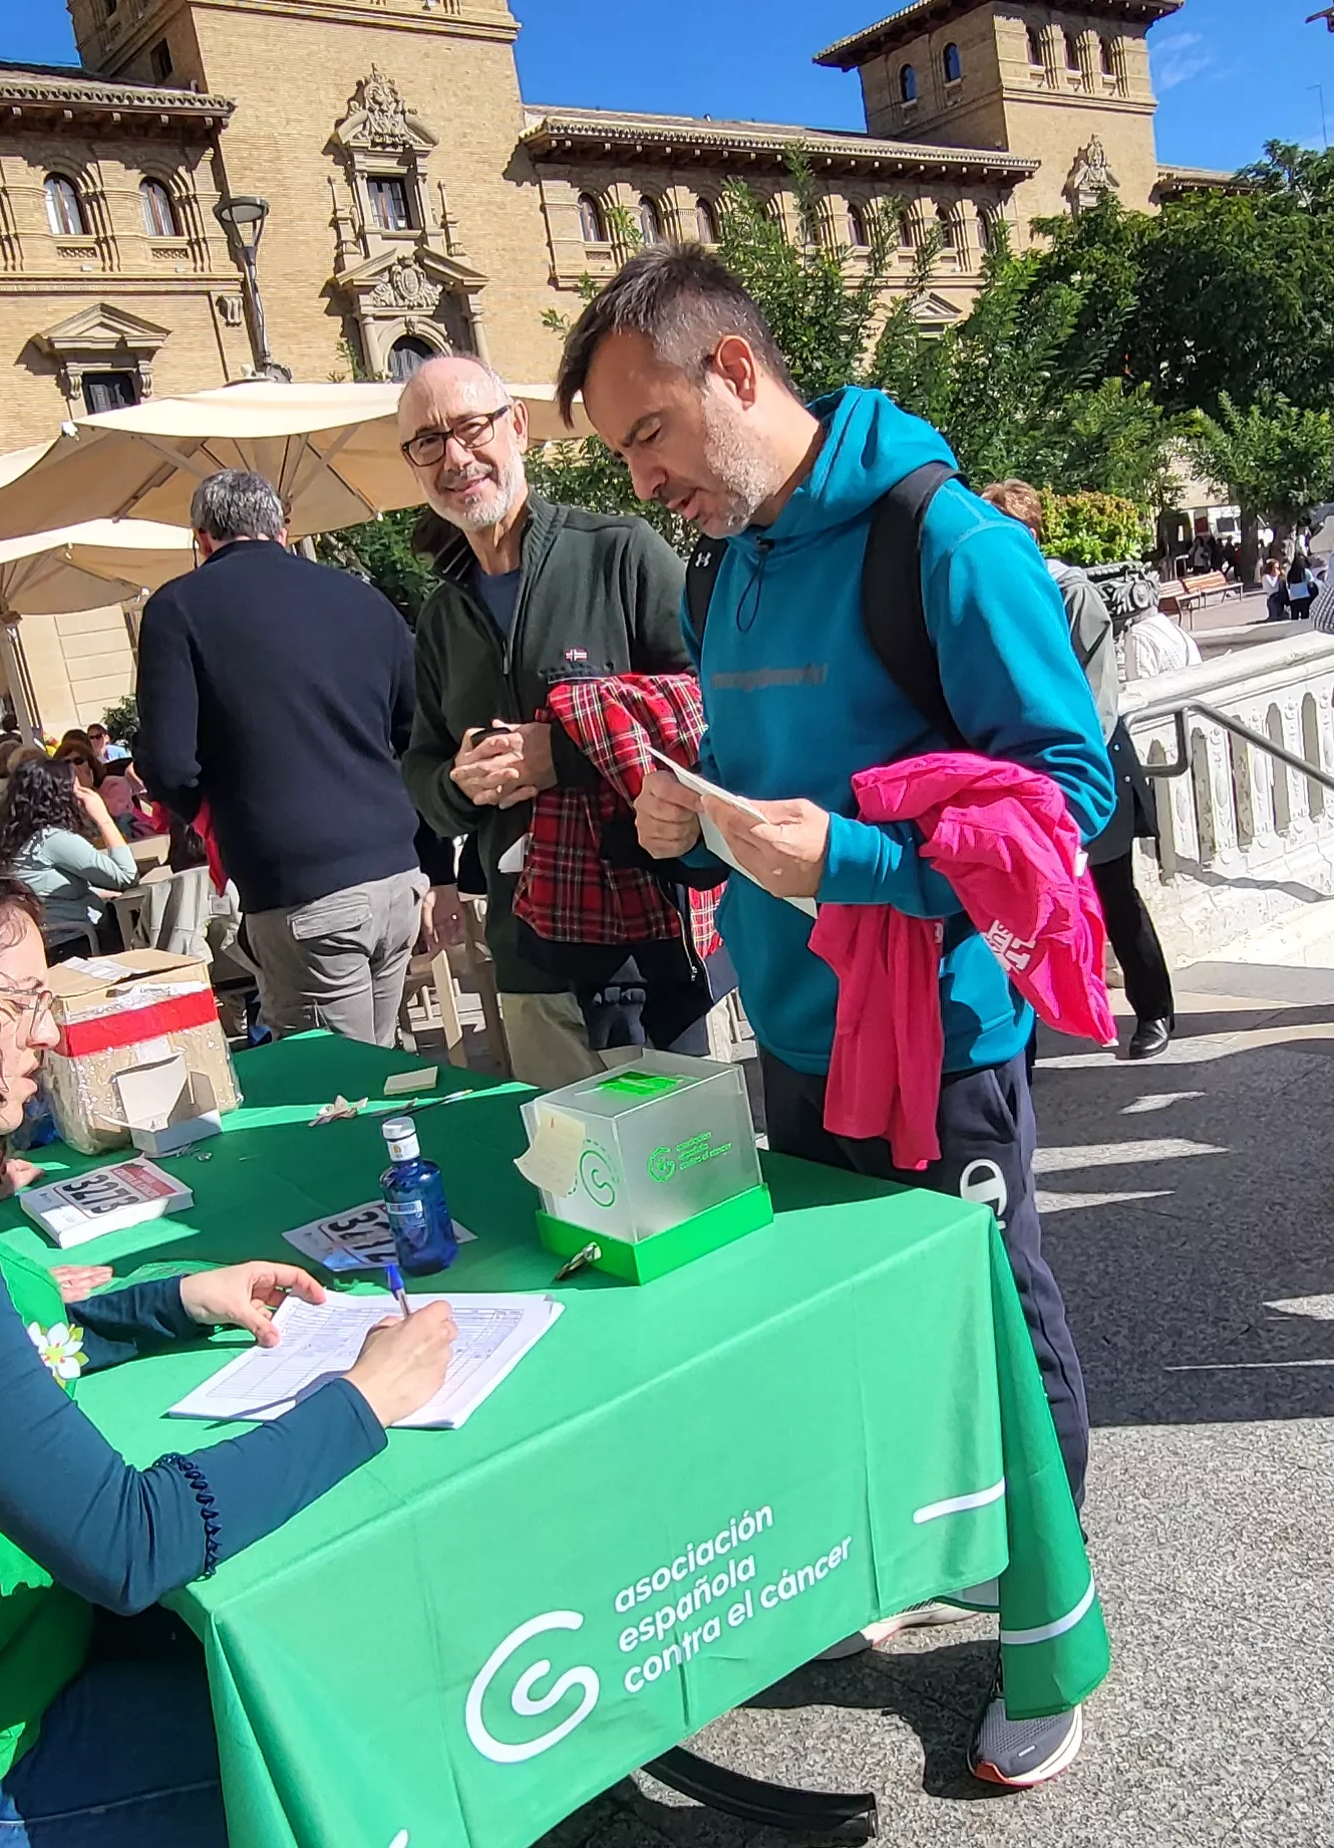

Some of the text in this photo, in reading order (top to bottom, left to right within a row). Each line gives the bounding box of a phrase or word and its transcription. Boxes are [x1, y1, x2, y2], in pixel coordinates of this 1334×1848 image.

[62, 1174, 140, 1214] 3273
[614, 1504, 774, 1613] asociación
[618, 1554, 757, 1653] española
[623, 1535, 853, 1694] contra el cáncer
